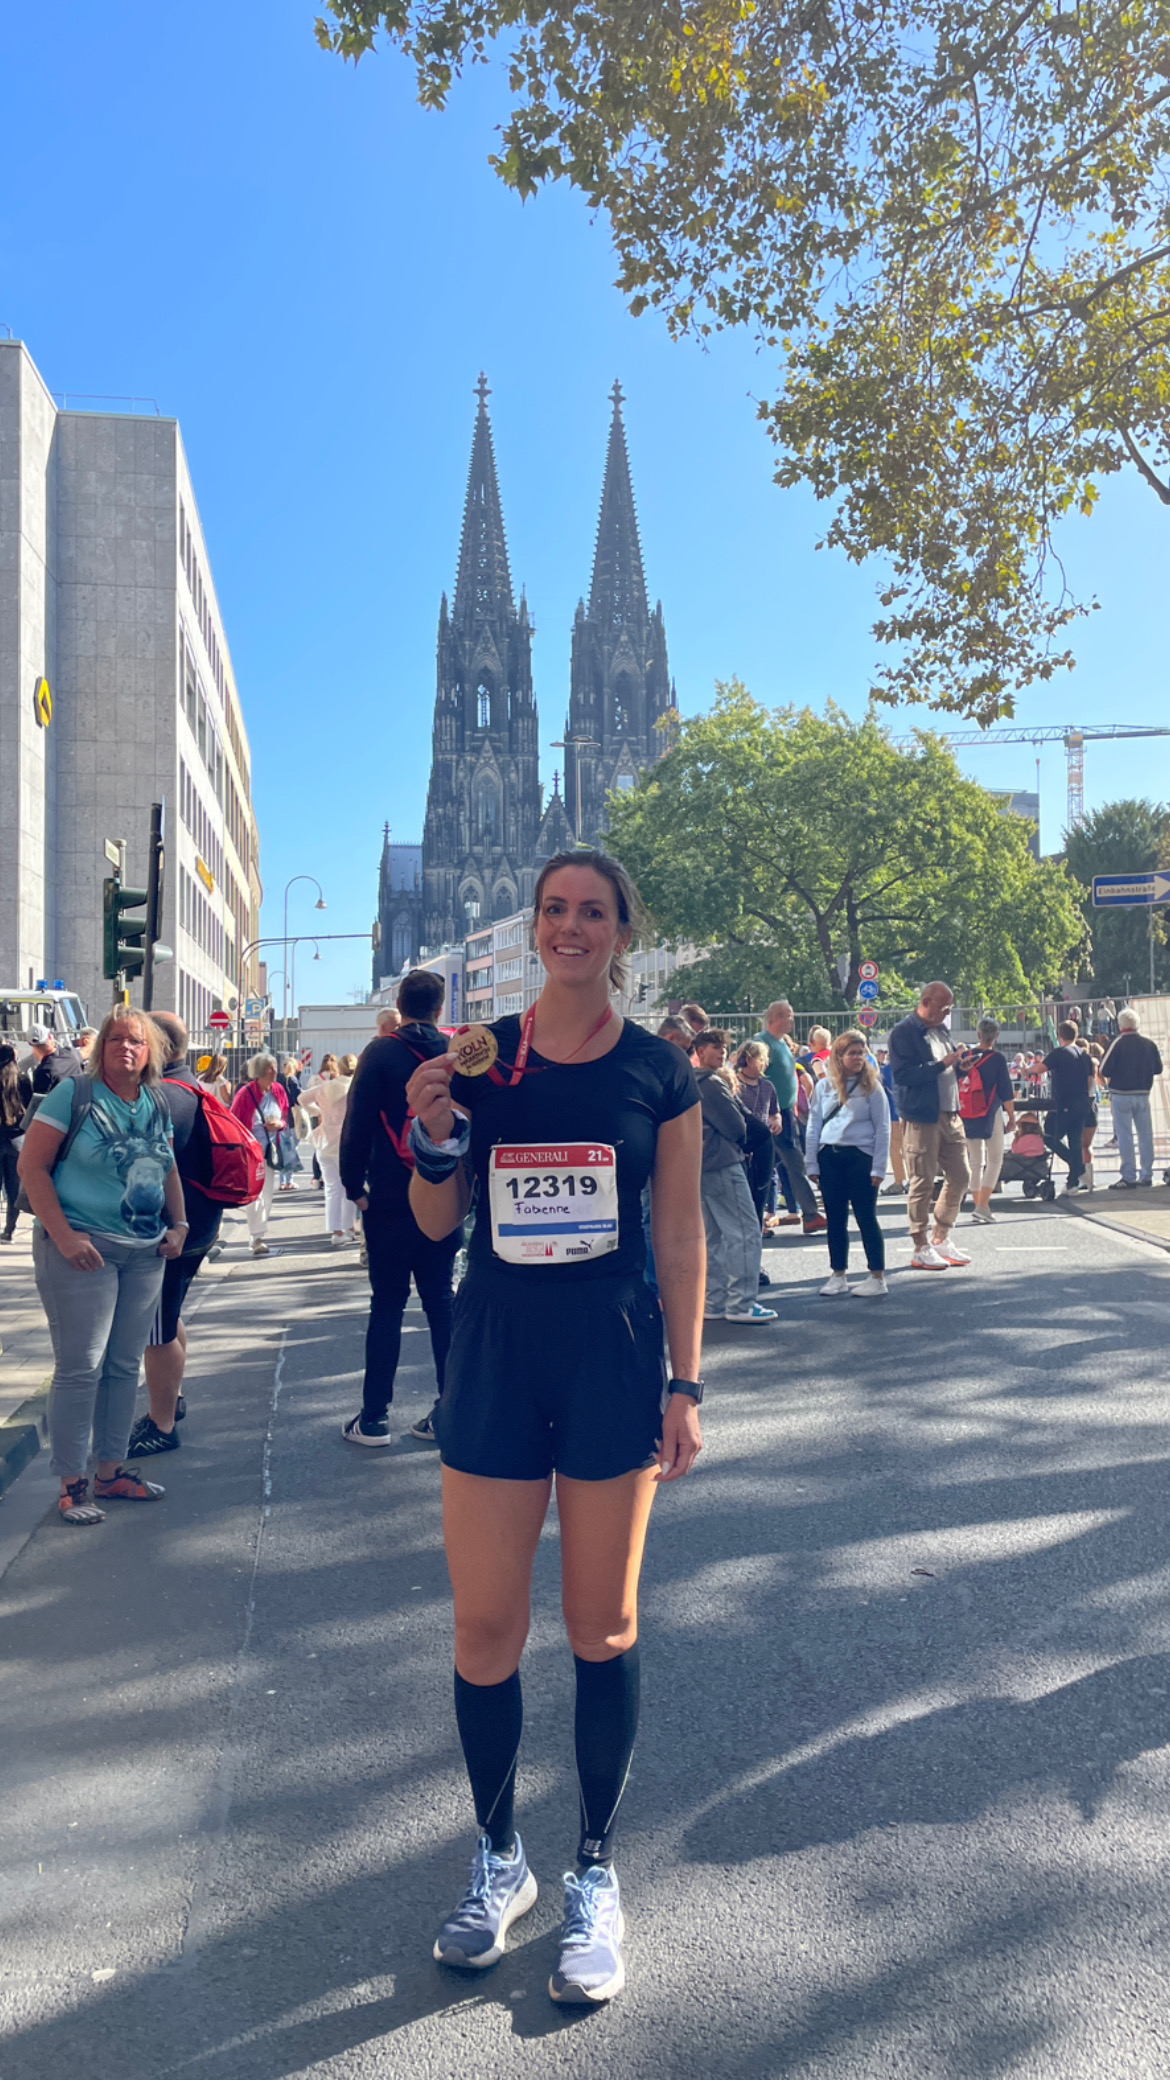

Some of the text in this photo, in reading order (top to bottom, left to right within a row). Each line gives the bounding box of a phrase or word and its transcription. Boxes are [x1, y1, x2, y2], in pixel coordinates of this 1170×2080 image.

[1098, 884, 1156, 895] Einbahnstraße
[252, 1005, 262, 1014] P
[515, 1151, 568, 1163] GENERALI
[506, 1175, 598, 1199] 12319
[566, 1247, 589, 1256] PUMA
